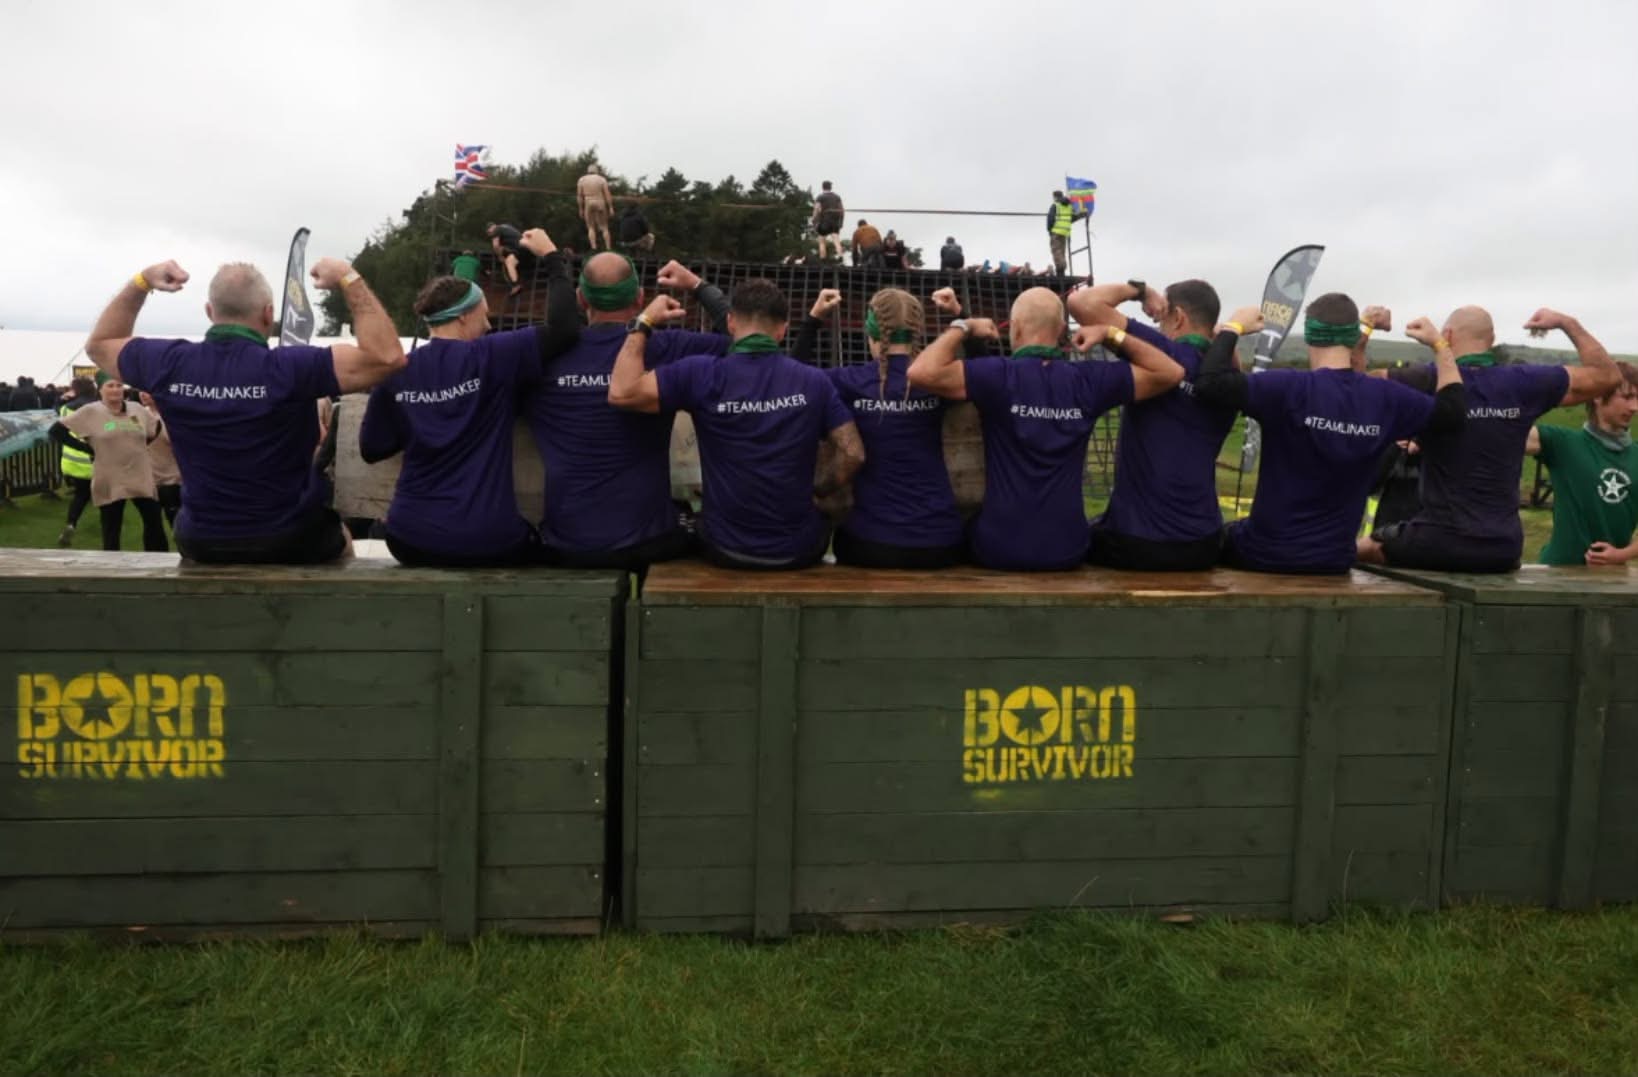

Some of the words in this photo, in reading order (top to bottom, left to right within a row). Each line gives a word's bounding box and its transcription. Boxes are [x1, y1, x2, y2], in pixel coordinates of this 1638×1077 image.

[168, 382, 269, 400] #TEAMLNAKER
[557, 374, 612, 388] #TEAMLI
[717, 393, 807, 414] #TEAMLINAKER
[1010, 404, 1083, 421] #EAMLINAKER
[18, 672, 225, 740] BORN
[963, 685, 1136, 747] BORN
[18, 740, 225, 779] SURVIVOR
[963, 744, 1135, 783] SURVIVOR
